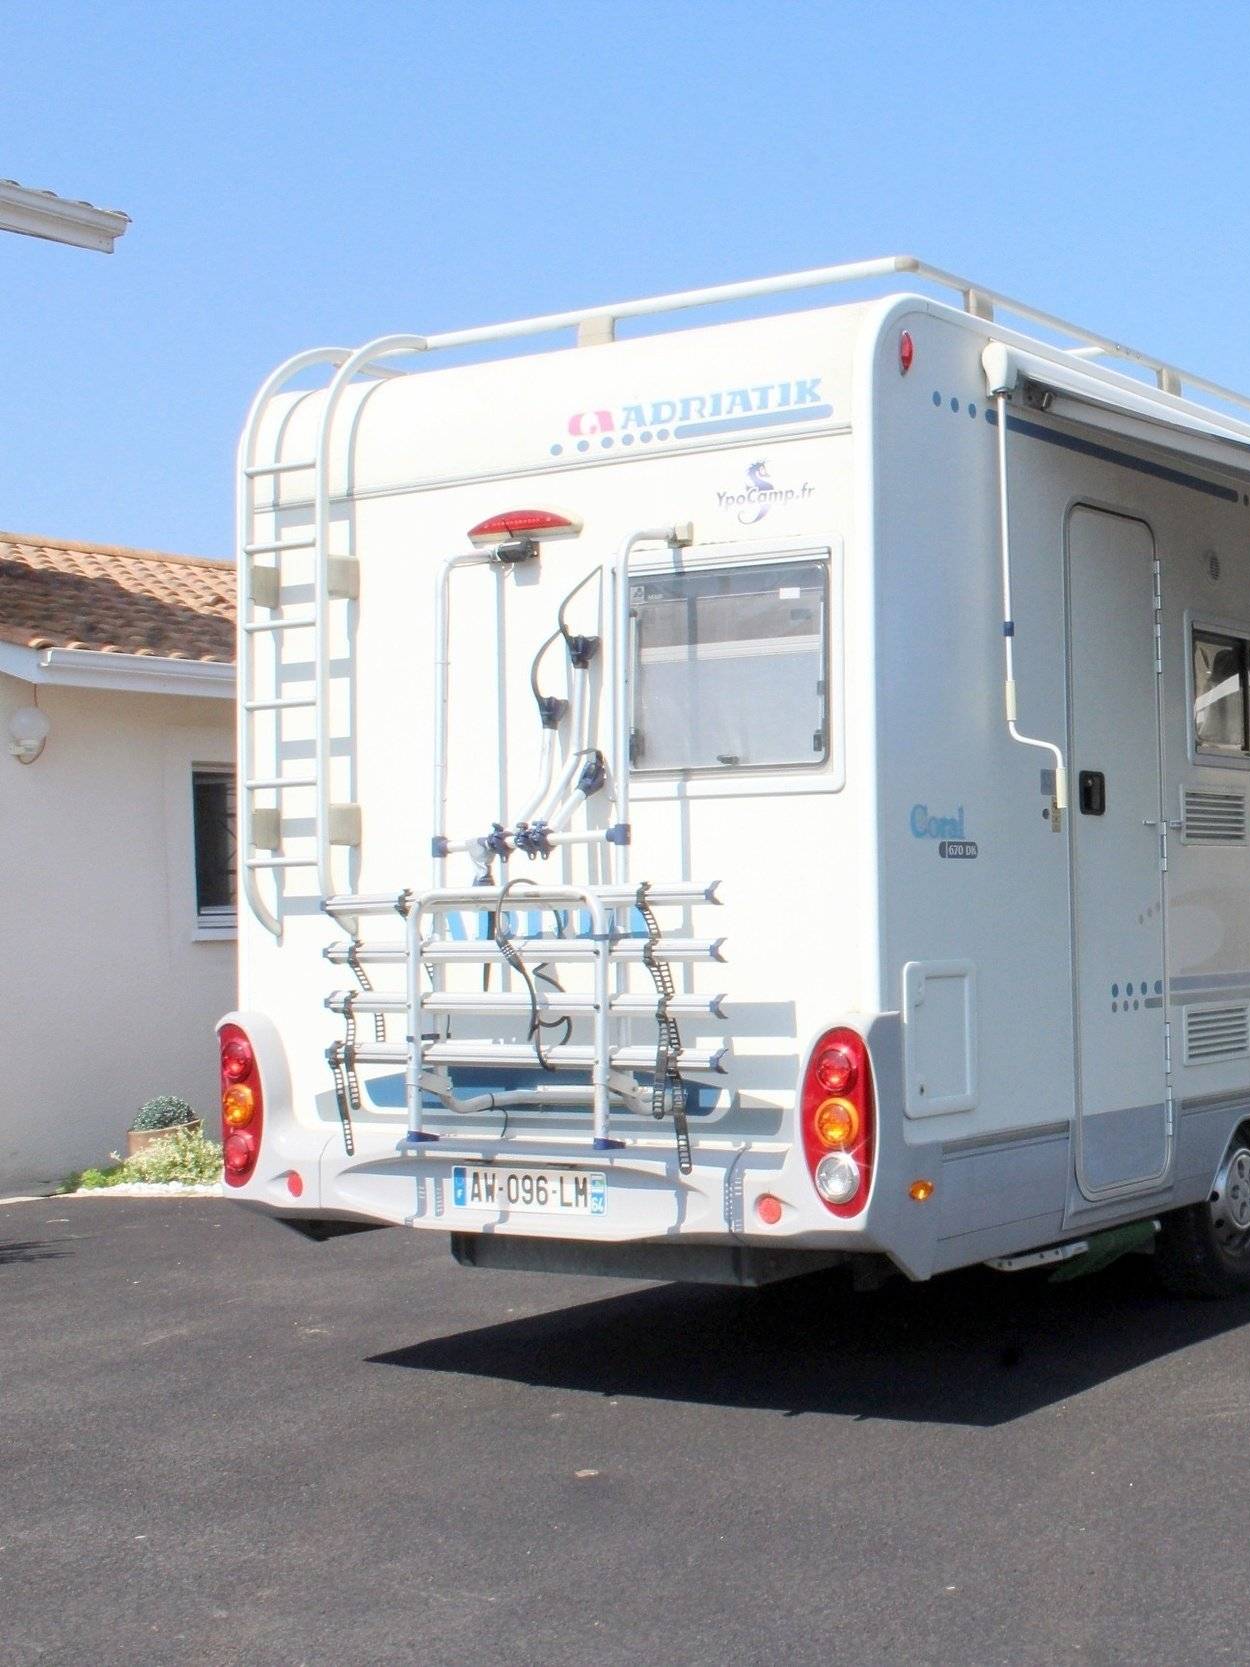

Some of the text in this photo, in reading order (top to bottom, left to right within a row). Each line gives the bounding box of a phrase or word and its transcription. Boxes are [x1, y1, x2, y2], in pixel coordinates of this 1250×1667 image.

[620, 378, 822, 430] ADRIATIK
[716, 482, 815, 509] YpoCamp.fr
[909, 803, 966, 840] Coral
[948, 844, 964, 856] 670
[470, 1171, 588, 1208] AW-096-LM
